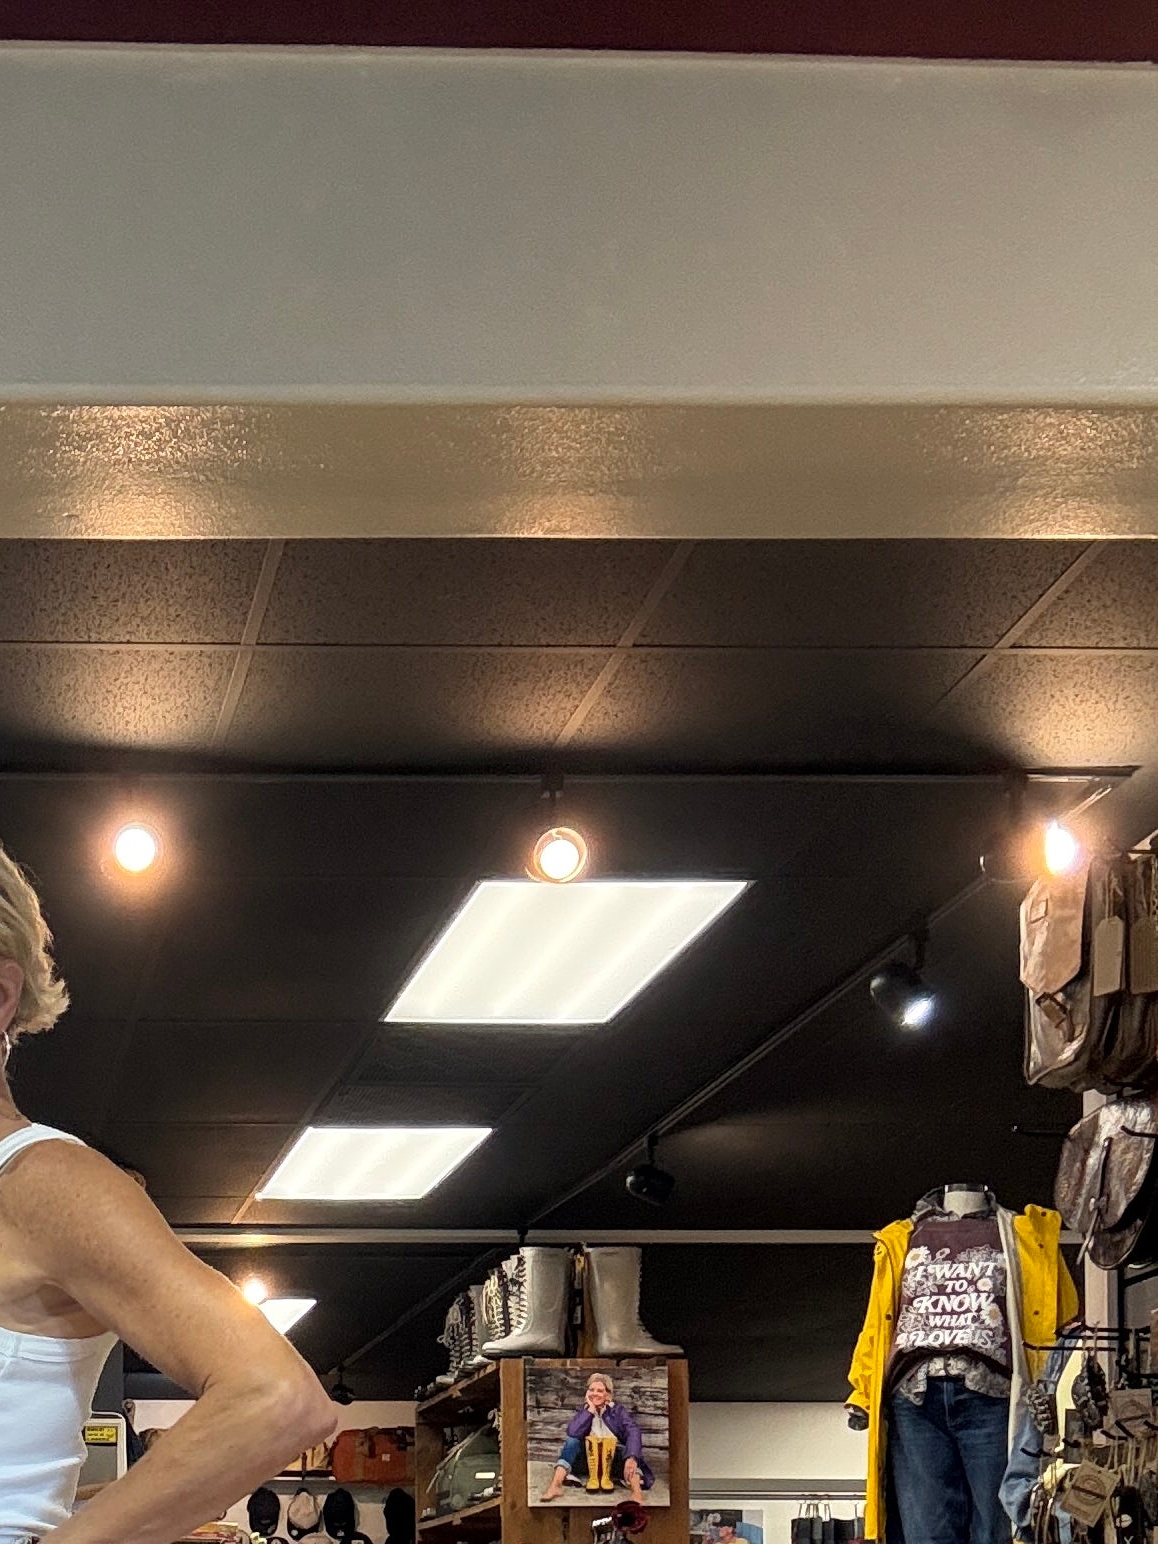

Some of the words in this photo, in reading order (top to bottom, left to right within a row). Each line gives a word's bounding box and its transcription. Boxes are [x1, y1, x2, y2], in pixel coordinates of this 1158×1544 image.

[927, 1262, 996, 1281] WANT
[944, 1279, 968, 1292] TO
[912, 1292, 996, 1314] KNOW
[928, 1312, 974, 1327] WHAT
[909, 1330, 972, 1347] LOVE
[974, 1330, 994, 1349] IS
